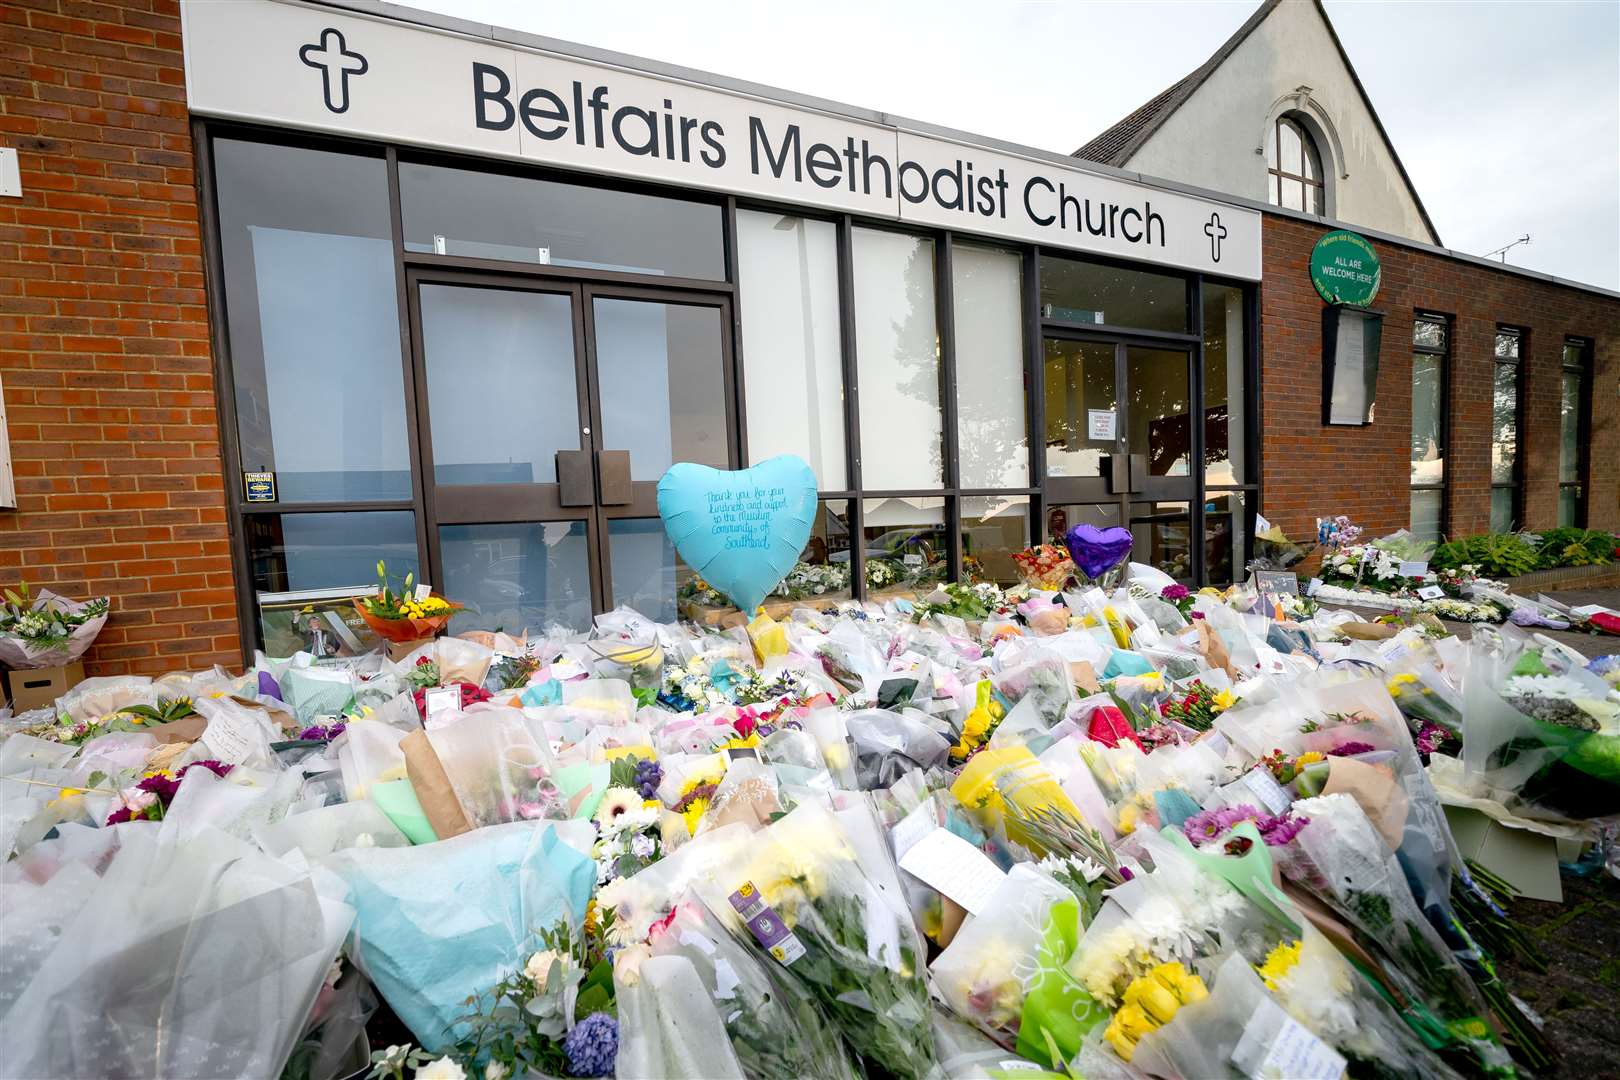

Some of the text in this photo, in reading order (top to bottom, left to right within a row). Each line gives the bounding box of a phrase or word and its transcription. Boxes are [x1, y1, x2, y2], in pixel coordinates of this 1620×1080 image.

[472, 61, 1167, 248] Belfairs Methodist Church
[1335, 256, 1362, 270] ALL ARE
[1322, 266, 1373, 284] WELCOME HERE
[705, 487, 785, 502] Thank you for your
[746, 500, 762, 510] and
[713, 515, 722, 524] to
[723, 510, 735, 521] the
[760, 521, 770, 535] of
